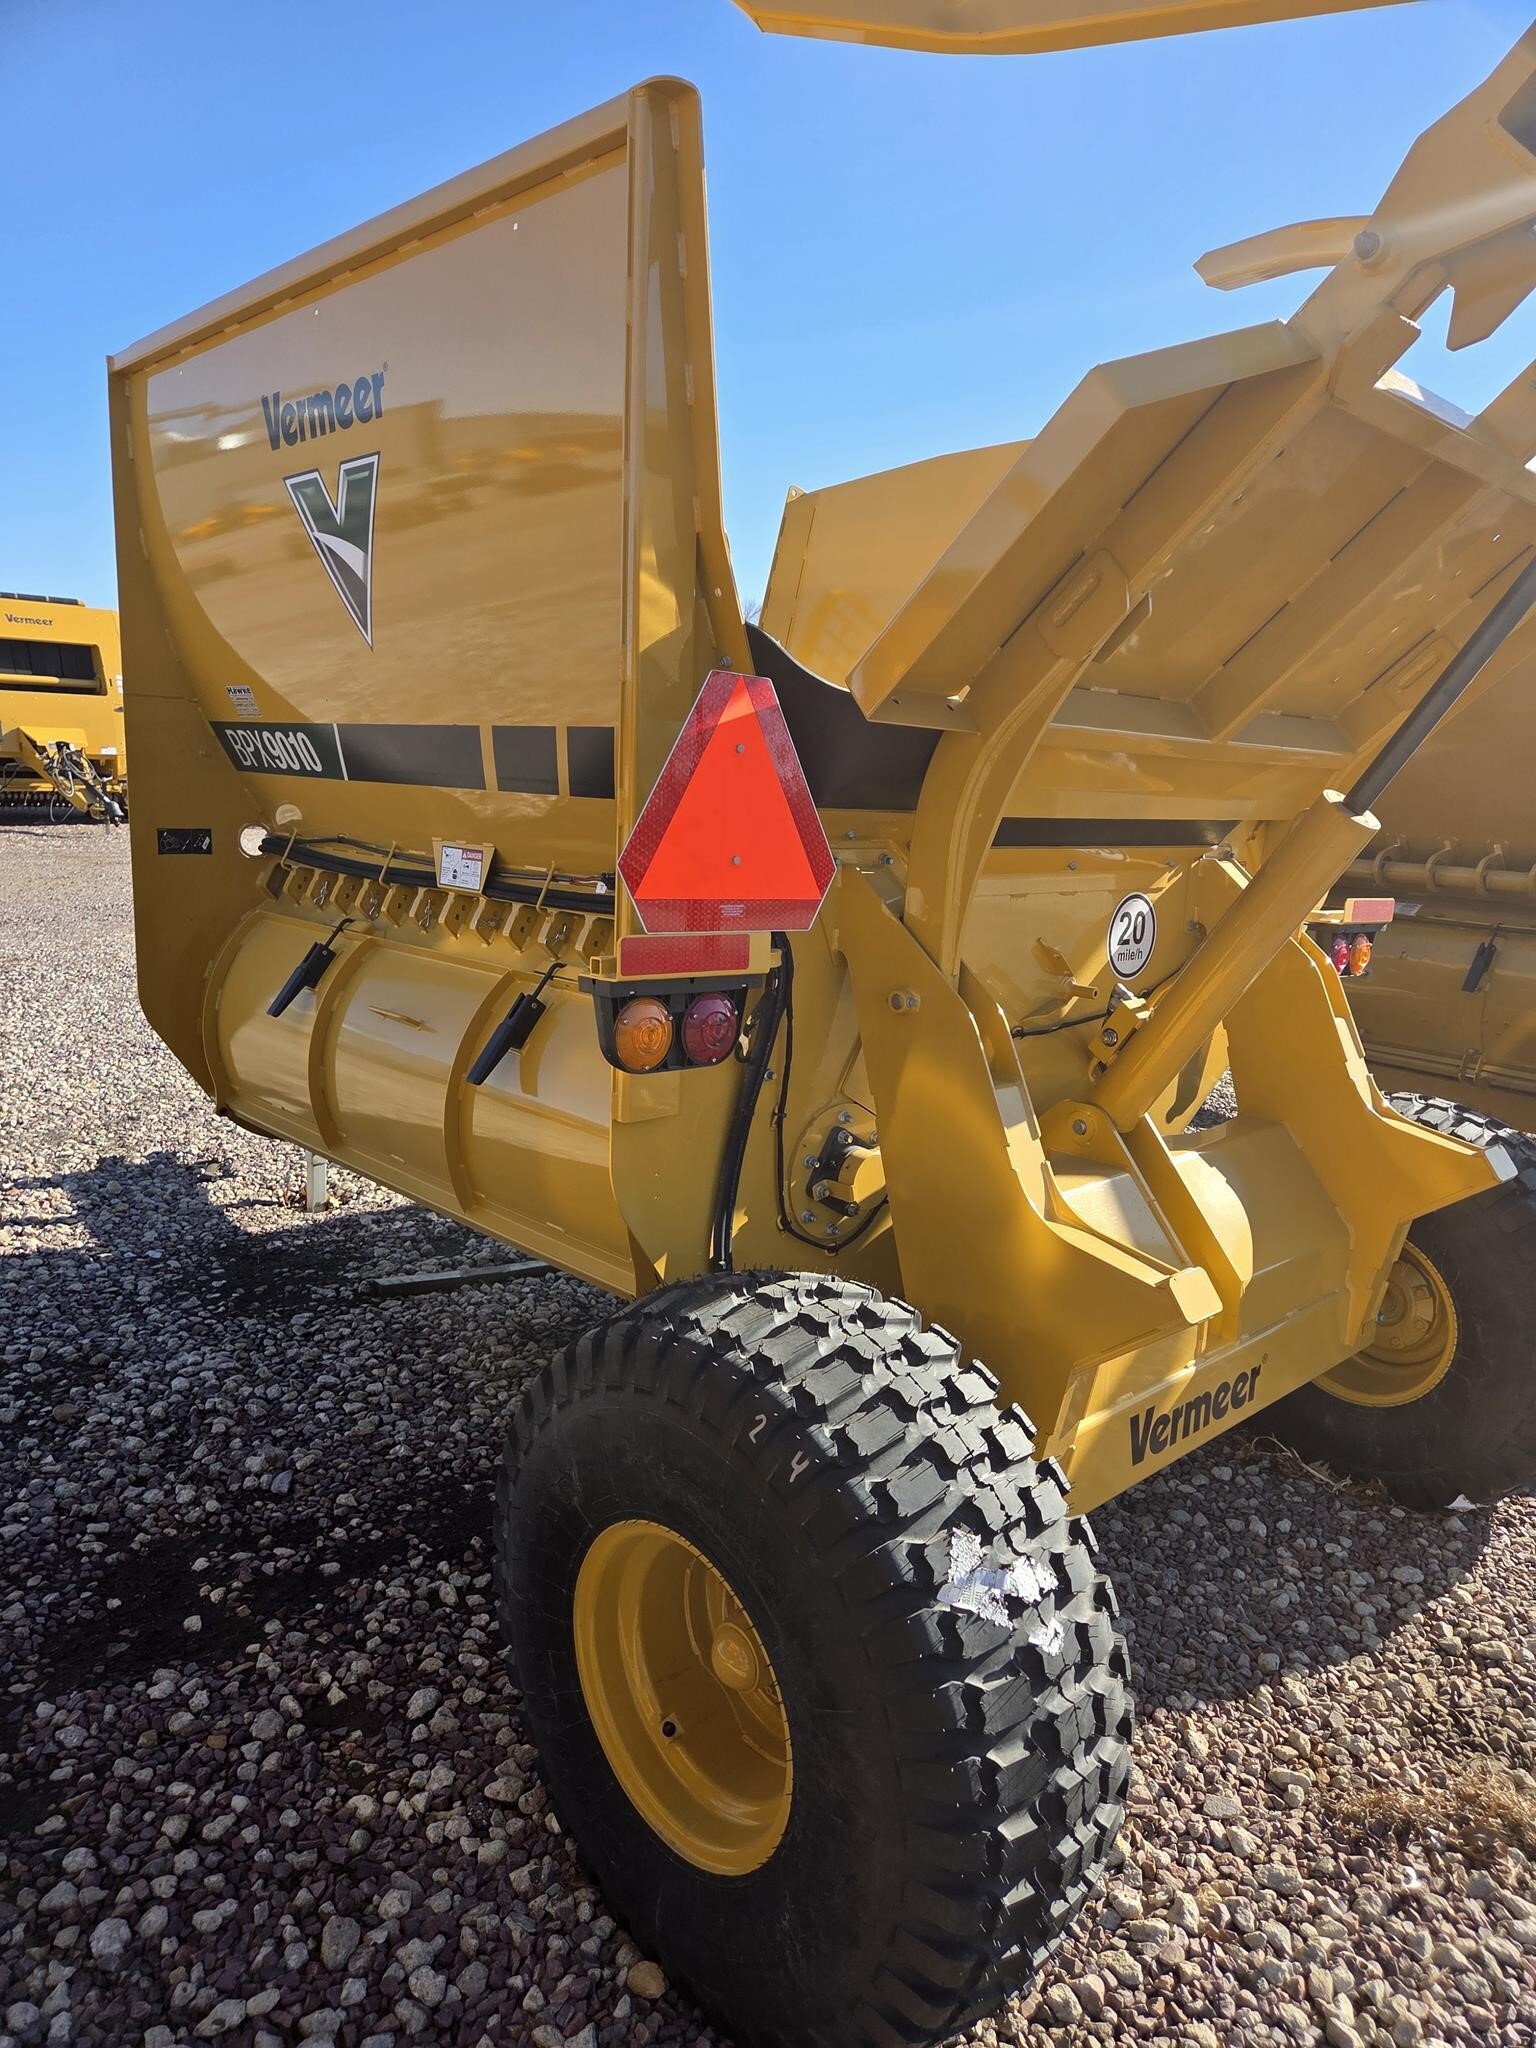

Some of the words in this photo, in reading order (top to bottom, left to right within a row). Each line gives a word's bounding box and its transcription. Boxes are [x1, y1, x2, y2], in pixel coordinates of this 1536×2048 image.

[260, 371, 385, 451] Vermeer
[4, 613, 54, 626] Vermeer
[224, 729, 323, 772] BPX9010
[1117, 910, 1146, 946] 20
[1117, 947, 1143, 962] mile/h
[1129, 1364, 1262, 1467] Vermeer
